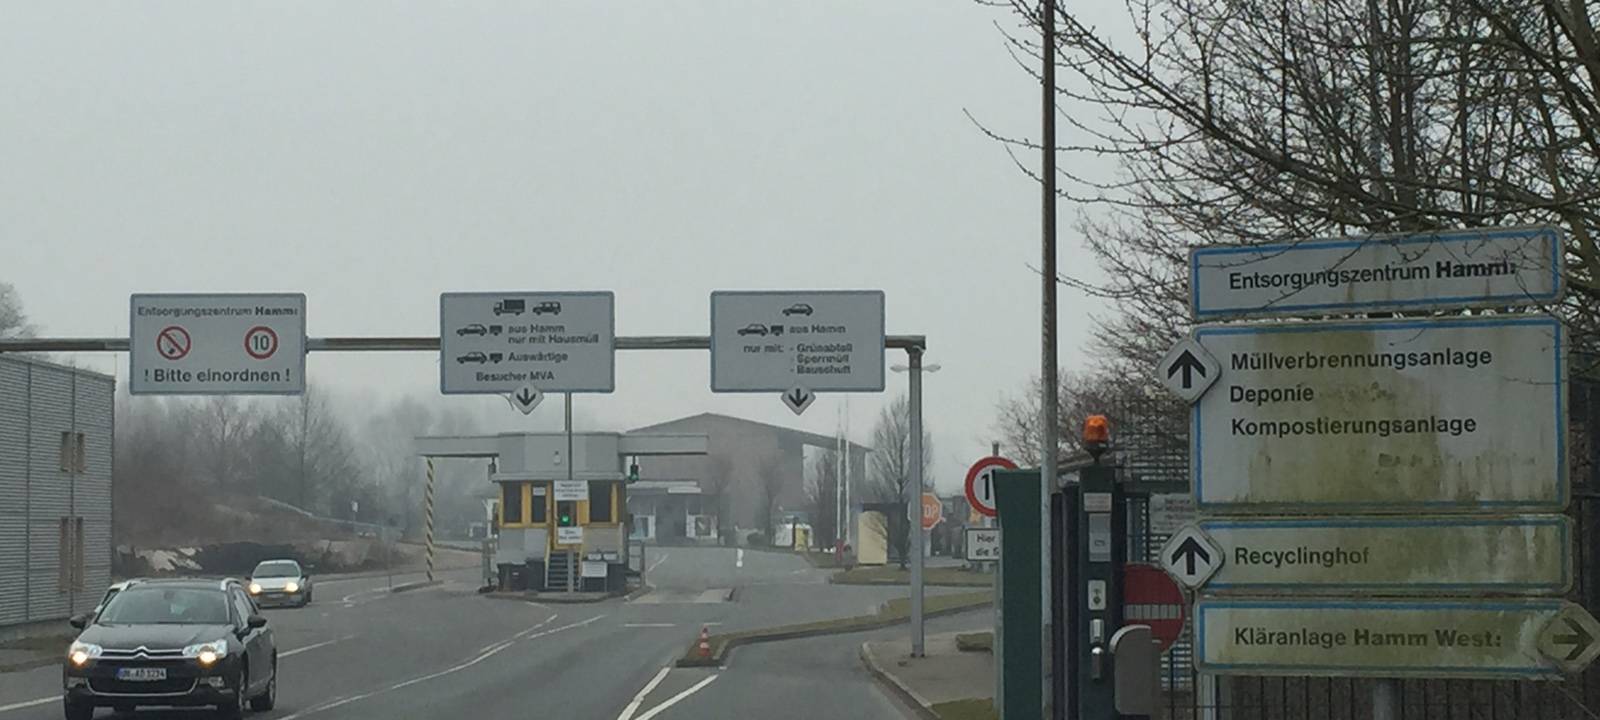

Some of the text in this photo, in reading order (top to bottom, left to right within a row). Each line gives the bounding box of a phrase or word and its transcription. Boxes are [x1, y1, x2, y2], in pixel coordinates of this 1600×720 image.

[1229, 262, 1430, 290] Entsorgungszentrum
[138, 306, 251, 317] Entsorgungszentrum
[508, 324, 565, 334] aus Hamm
[789, 324, 846, 334] aus Hamm
[253, 335, 270, 351] 10
[508, 333, 599, 344] nur mit Hausmüll
[743, 344, 761, 353] nur
[508, 351, 568, 364] Auswärtige
[1231, 346, 1493, 371] Müllverbrennungsanlage
[154, 368, 192, 382] Bitte
[197, 368, 281, 382] einordnen
[476, 371, 555, 382] Besucher MVA
[1230, 383, 1314, 407] Deponie
[1231, 414, 1477, 438] Kompostierungsanlage
[977, 533, 996, 543] Hier
[1234, 546, 1370, 569] Recyclinghof
[1234, 627, 1502, 650] Kläranlage Hamm West:
